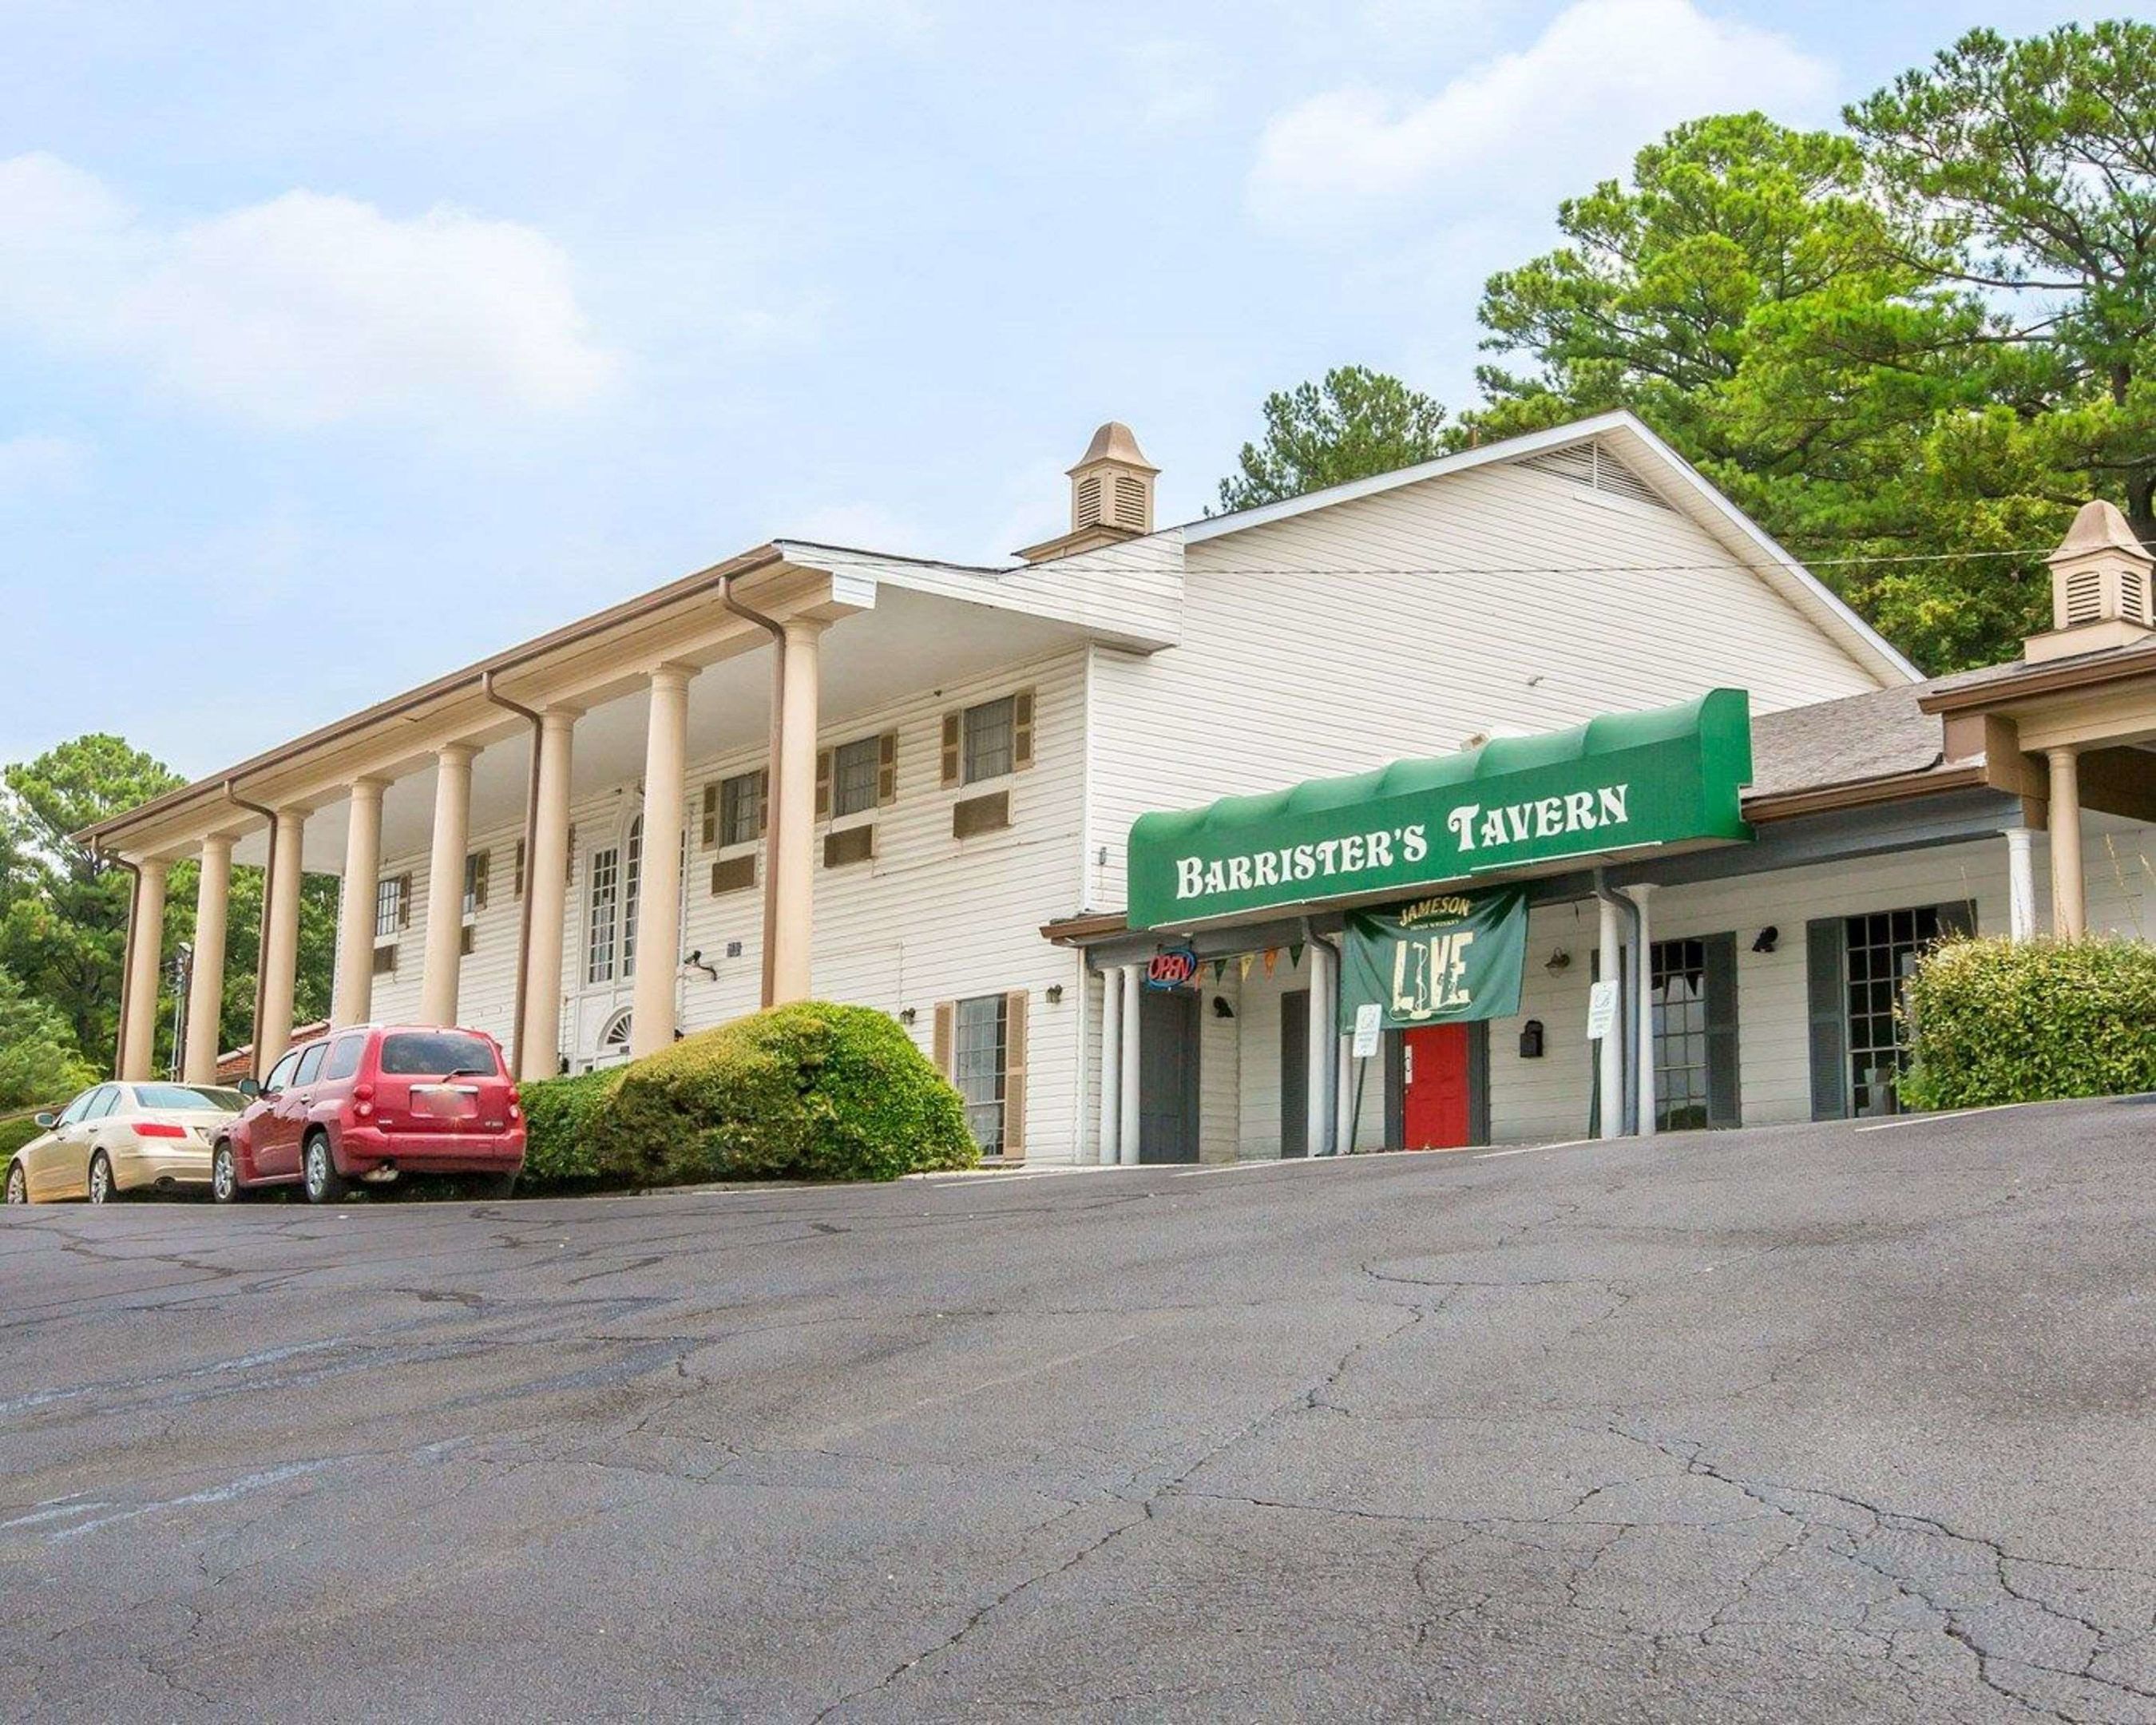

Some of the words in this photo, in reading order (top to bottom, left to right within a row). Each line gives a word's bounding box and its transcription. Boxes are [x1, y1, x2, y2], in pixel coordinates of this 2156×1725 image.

[1176, 824, 1428, 899] BARRISTER'S
[1449, 784, 1628, 852] TAVERN
[1399, 897, 1470, 926] JAMESON
[1148, 955, 1188, 981] OPEN
